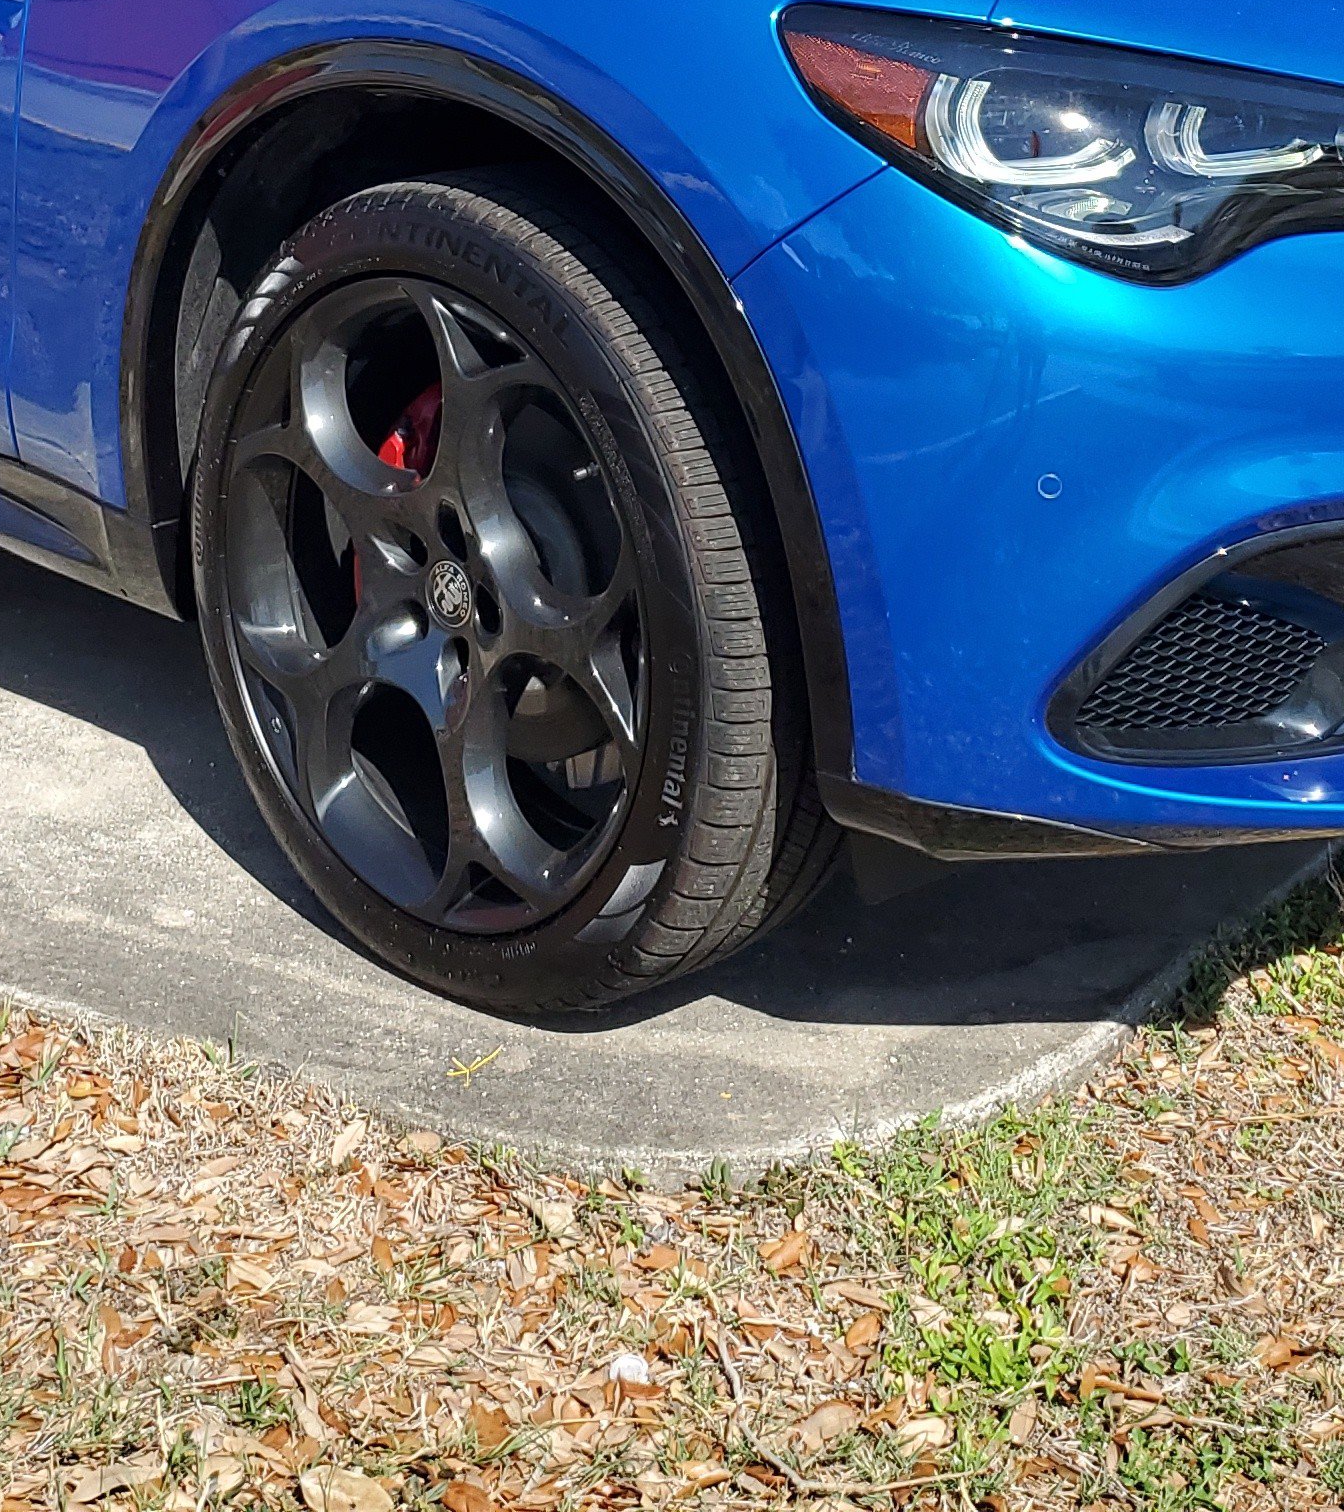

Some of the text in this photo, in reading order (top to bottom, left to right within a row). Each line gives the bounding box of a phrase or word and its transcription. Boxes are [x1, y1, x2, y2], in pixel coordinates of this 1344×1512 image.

[348, 220, 571, 352] NTINENTAL
[435, 564, 469, 618] ALFA ROMEO
